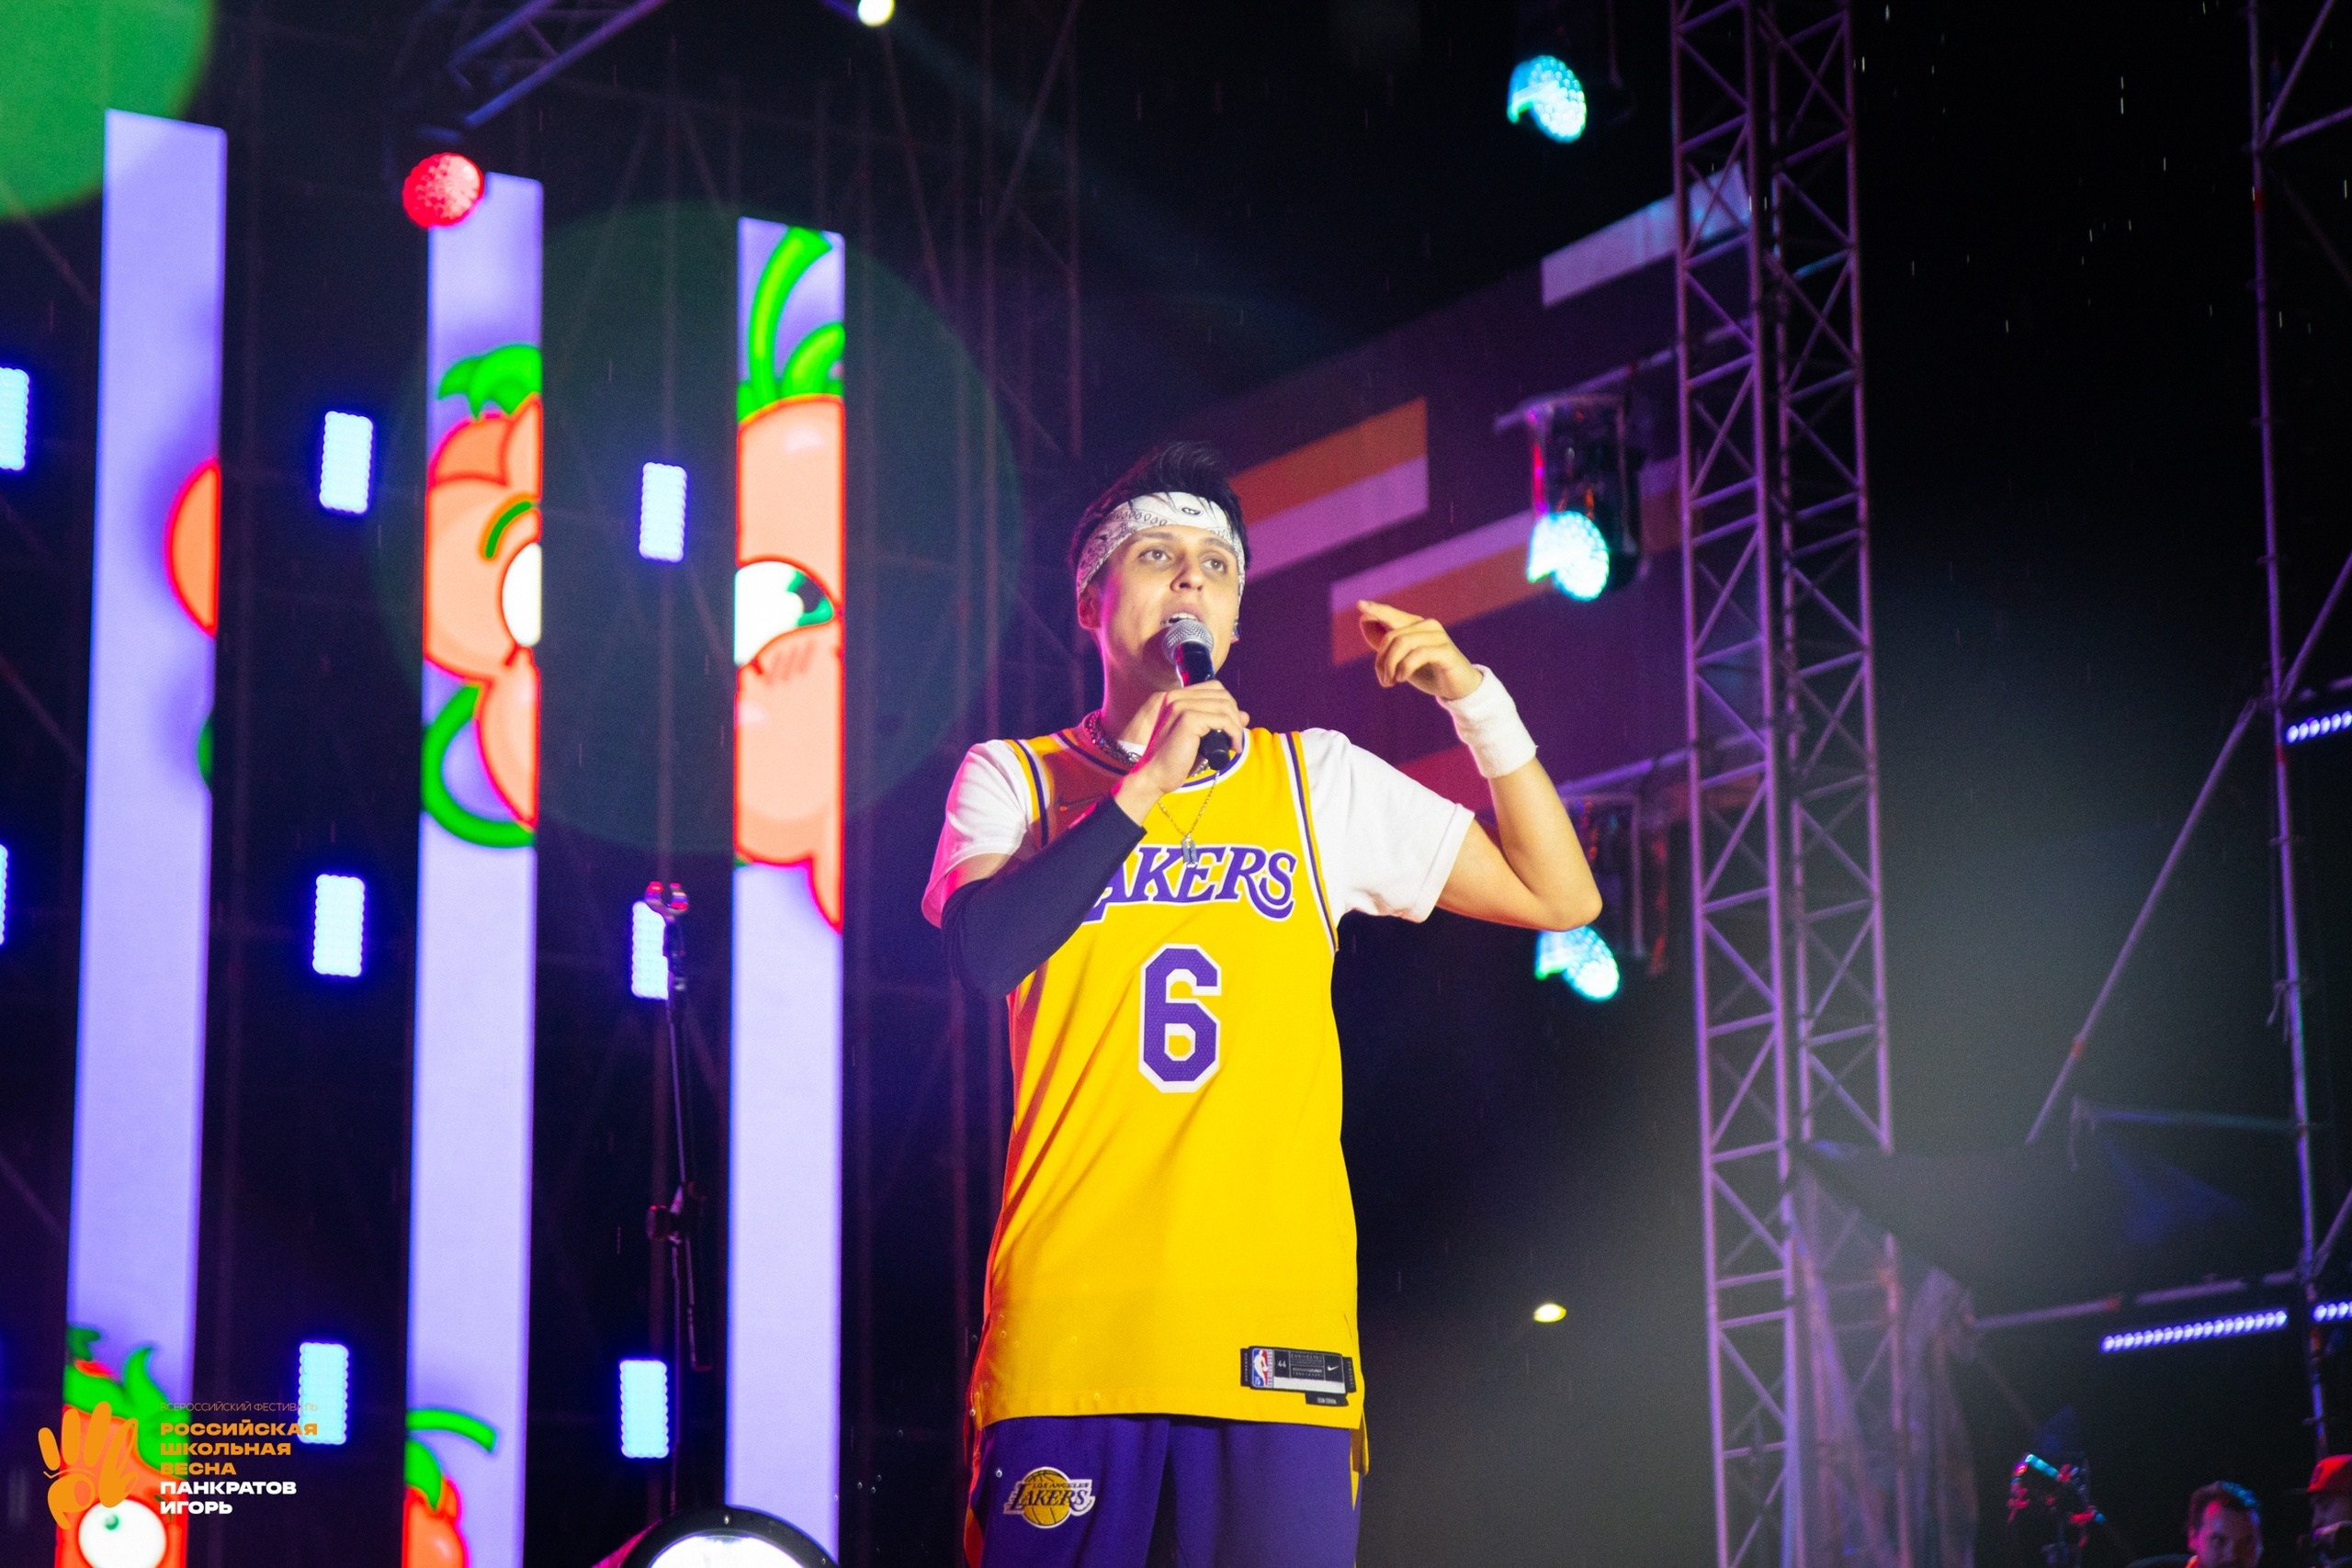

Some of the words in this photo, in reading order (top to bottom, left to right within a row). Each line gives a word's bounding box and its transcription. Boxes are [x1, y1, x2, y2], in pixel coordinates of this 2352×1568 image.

[1138, 943, 1222, 1093] 6
[1277, 1359, 1287, 1369] 44
[1006, 1482, 1093, 1514] LAKERS
